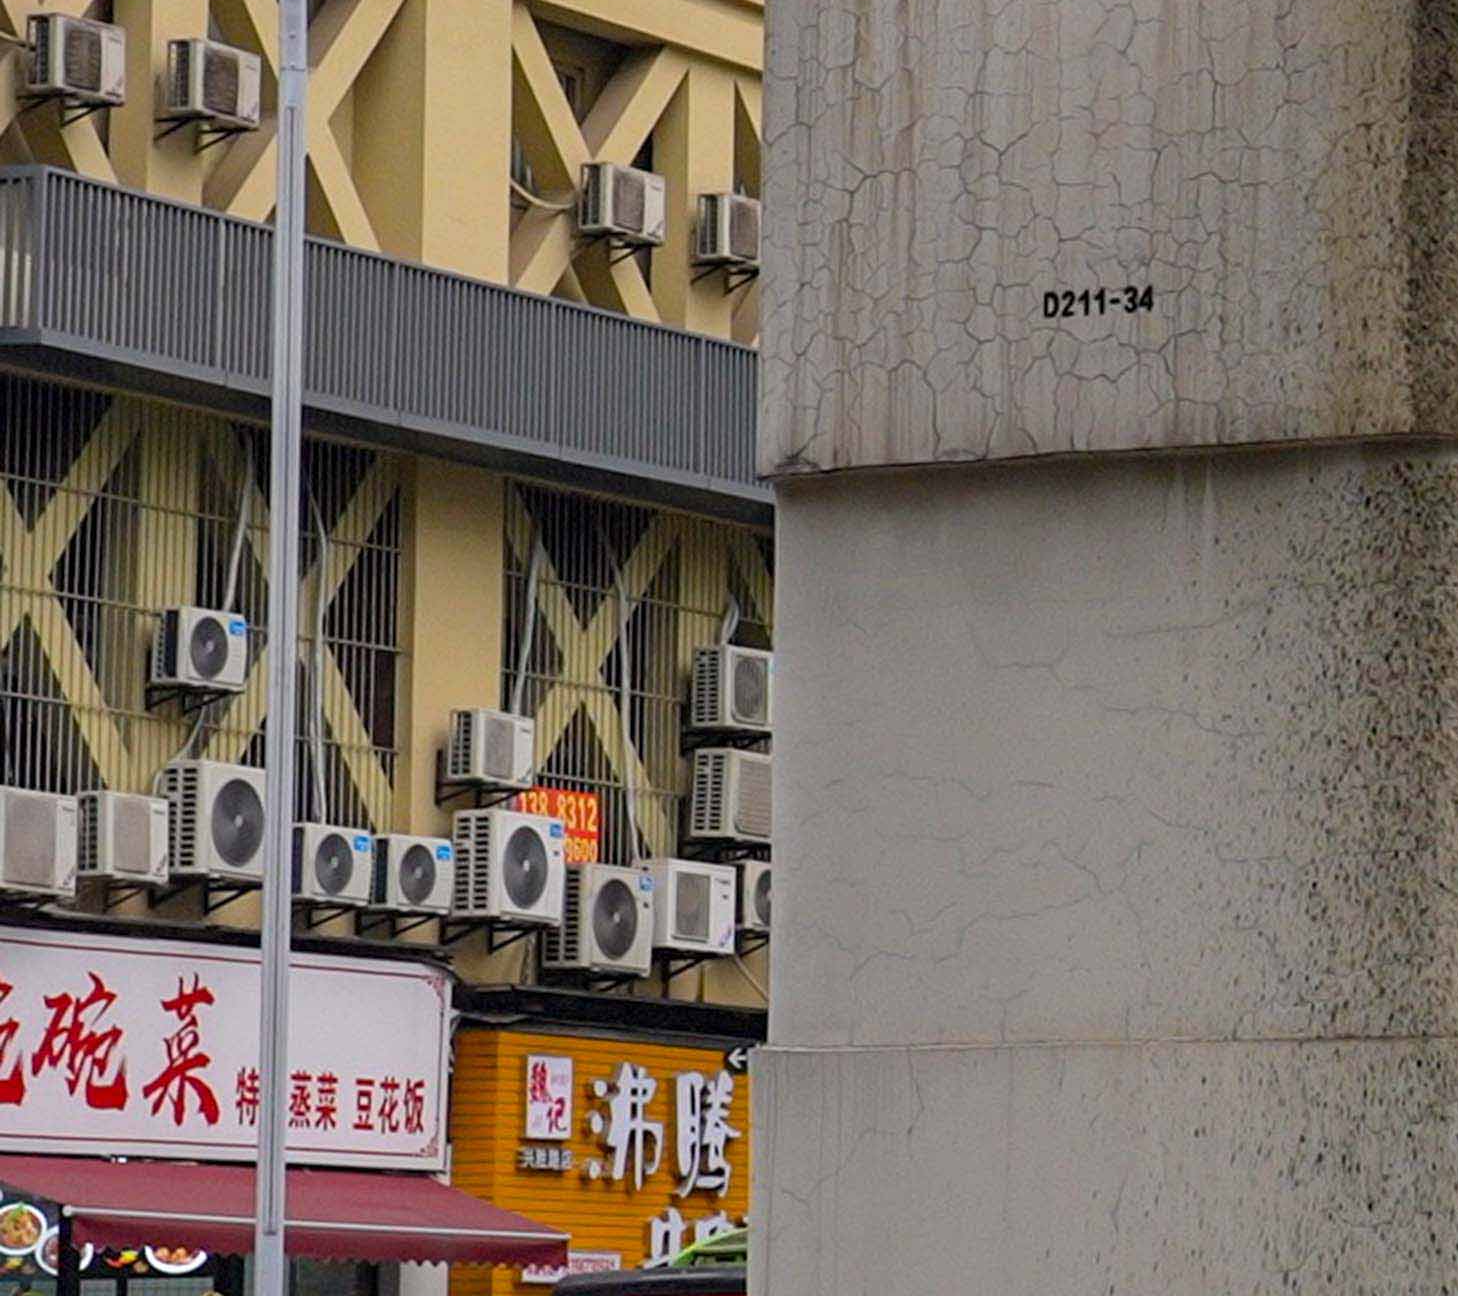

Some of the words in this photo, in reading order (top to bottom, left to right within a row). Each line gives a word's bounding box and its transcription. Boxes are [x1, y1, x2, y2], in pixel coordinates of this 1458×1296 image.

[1043, 285, 1154, 318] D211-34
[352, 1076, 426, 1134] 豆花饭
